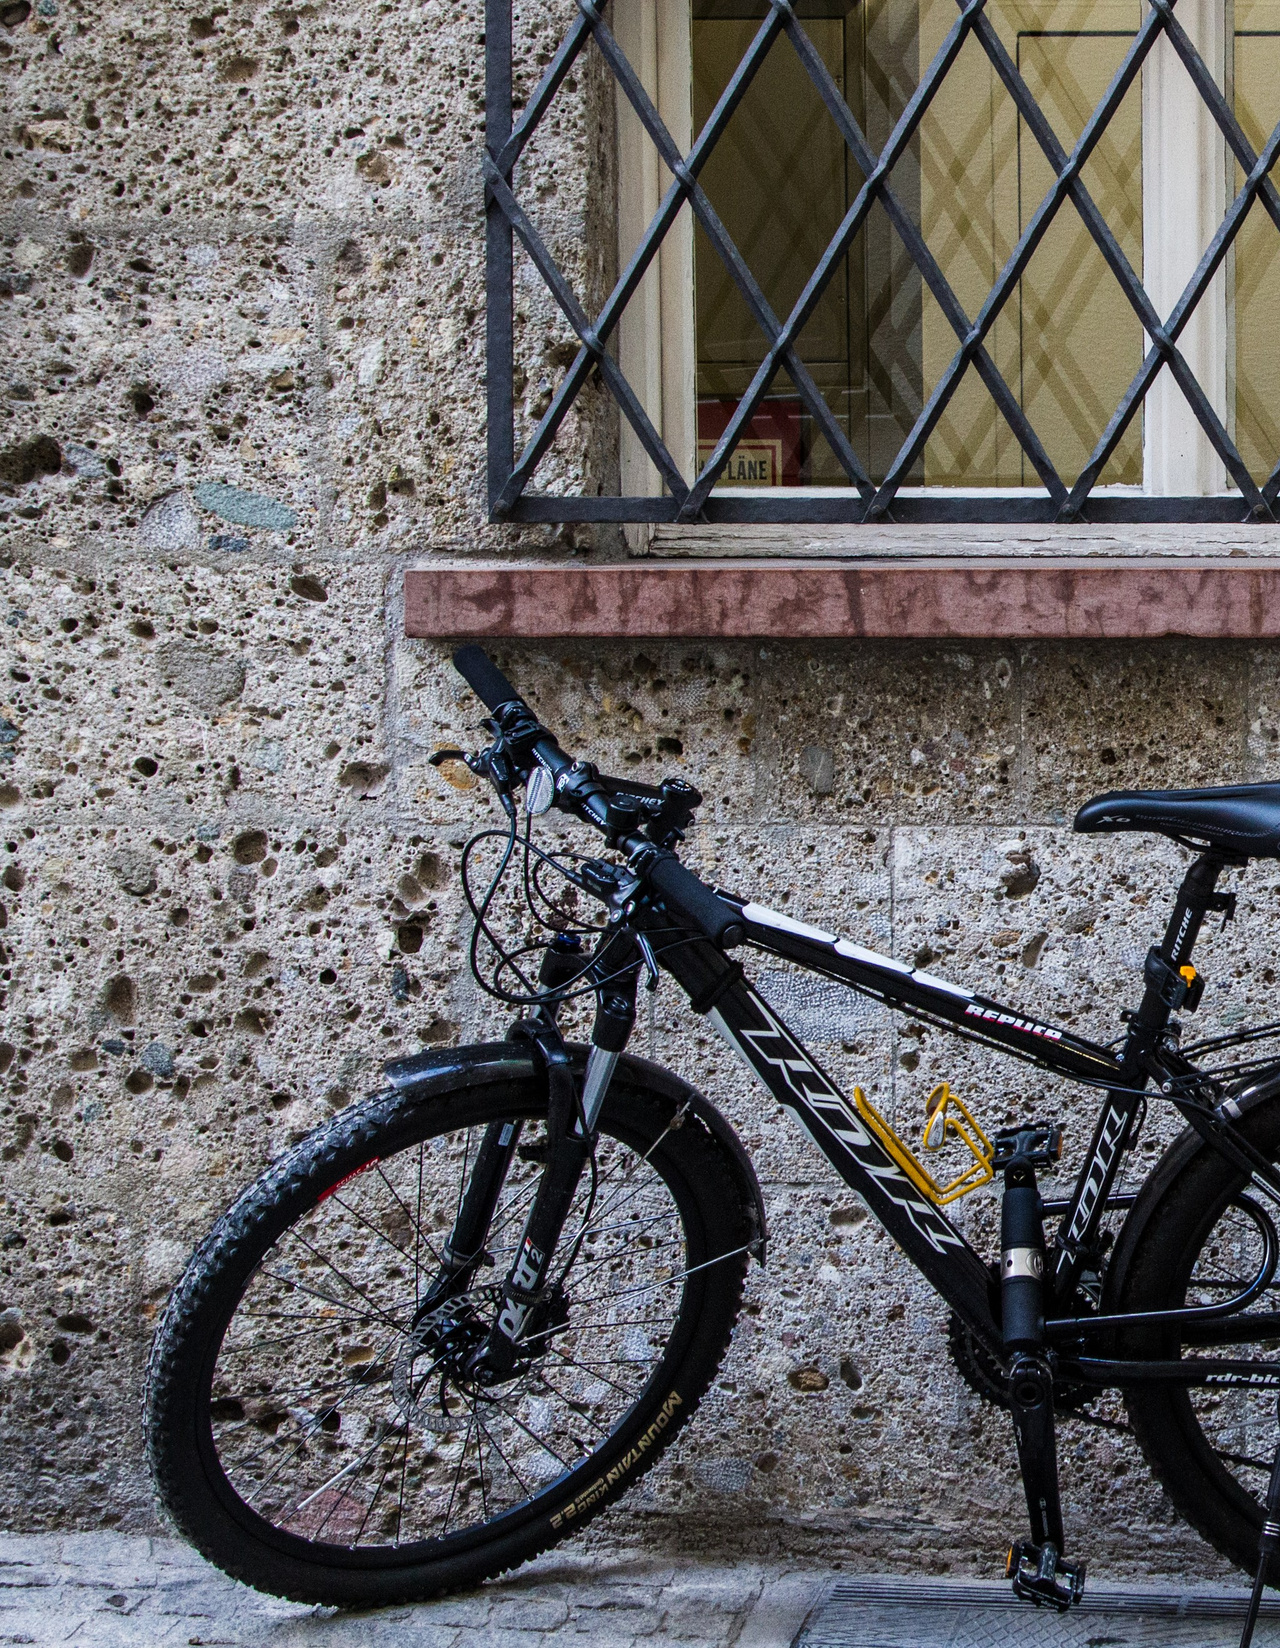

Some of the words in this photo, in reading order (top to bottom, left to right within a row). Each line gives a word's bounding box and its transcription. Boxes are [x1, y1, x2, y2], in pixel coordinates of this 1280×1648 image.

[606, 1390, 683, 1486] MOUNTAIN
[577, 1483, 609, 1513] KING
[549, 1502, 577, 1530] 2.2
